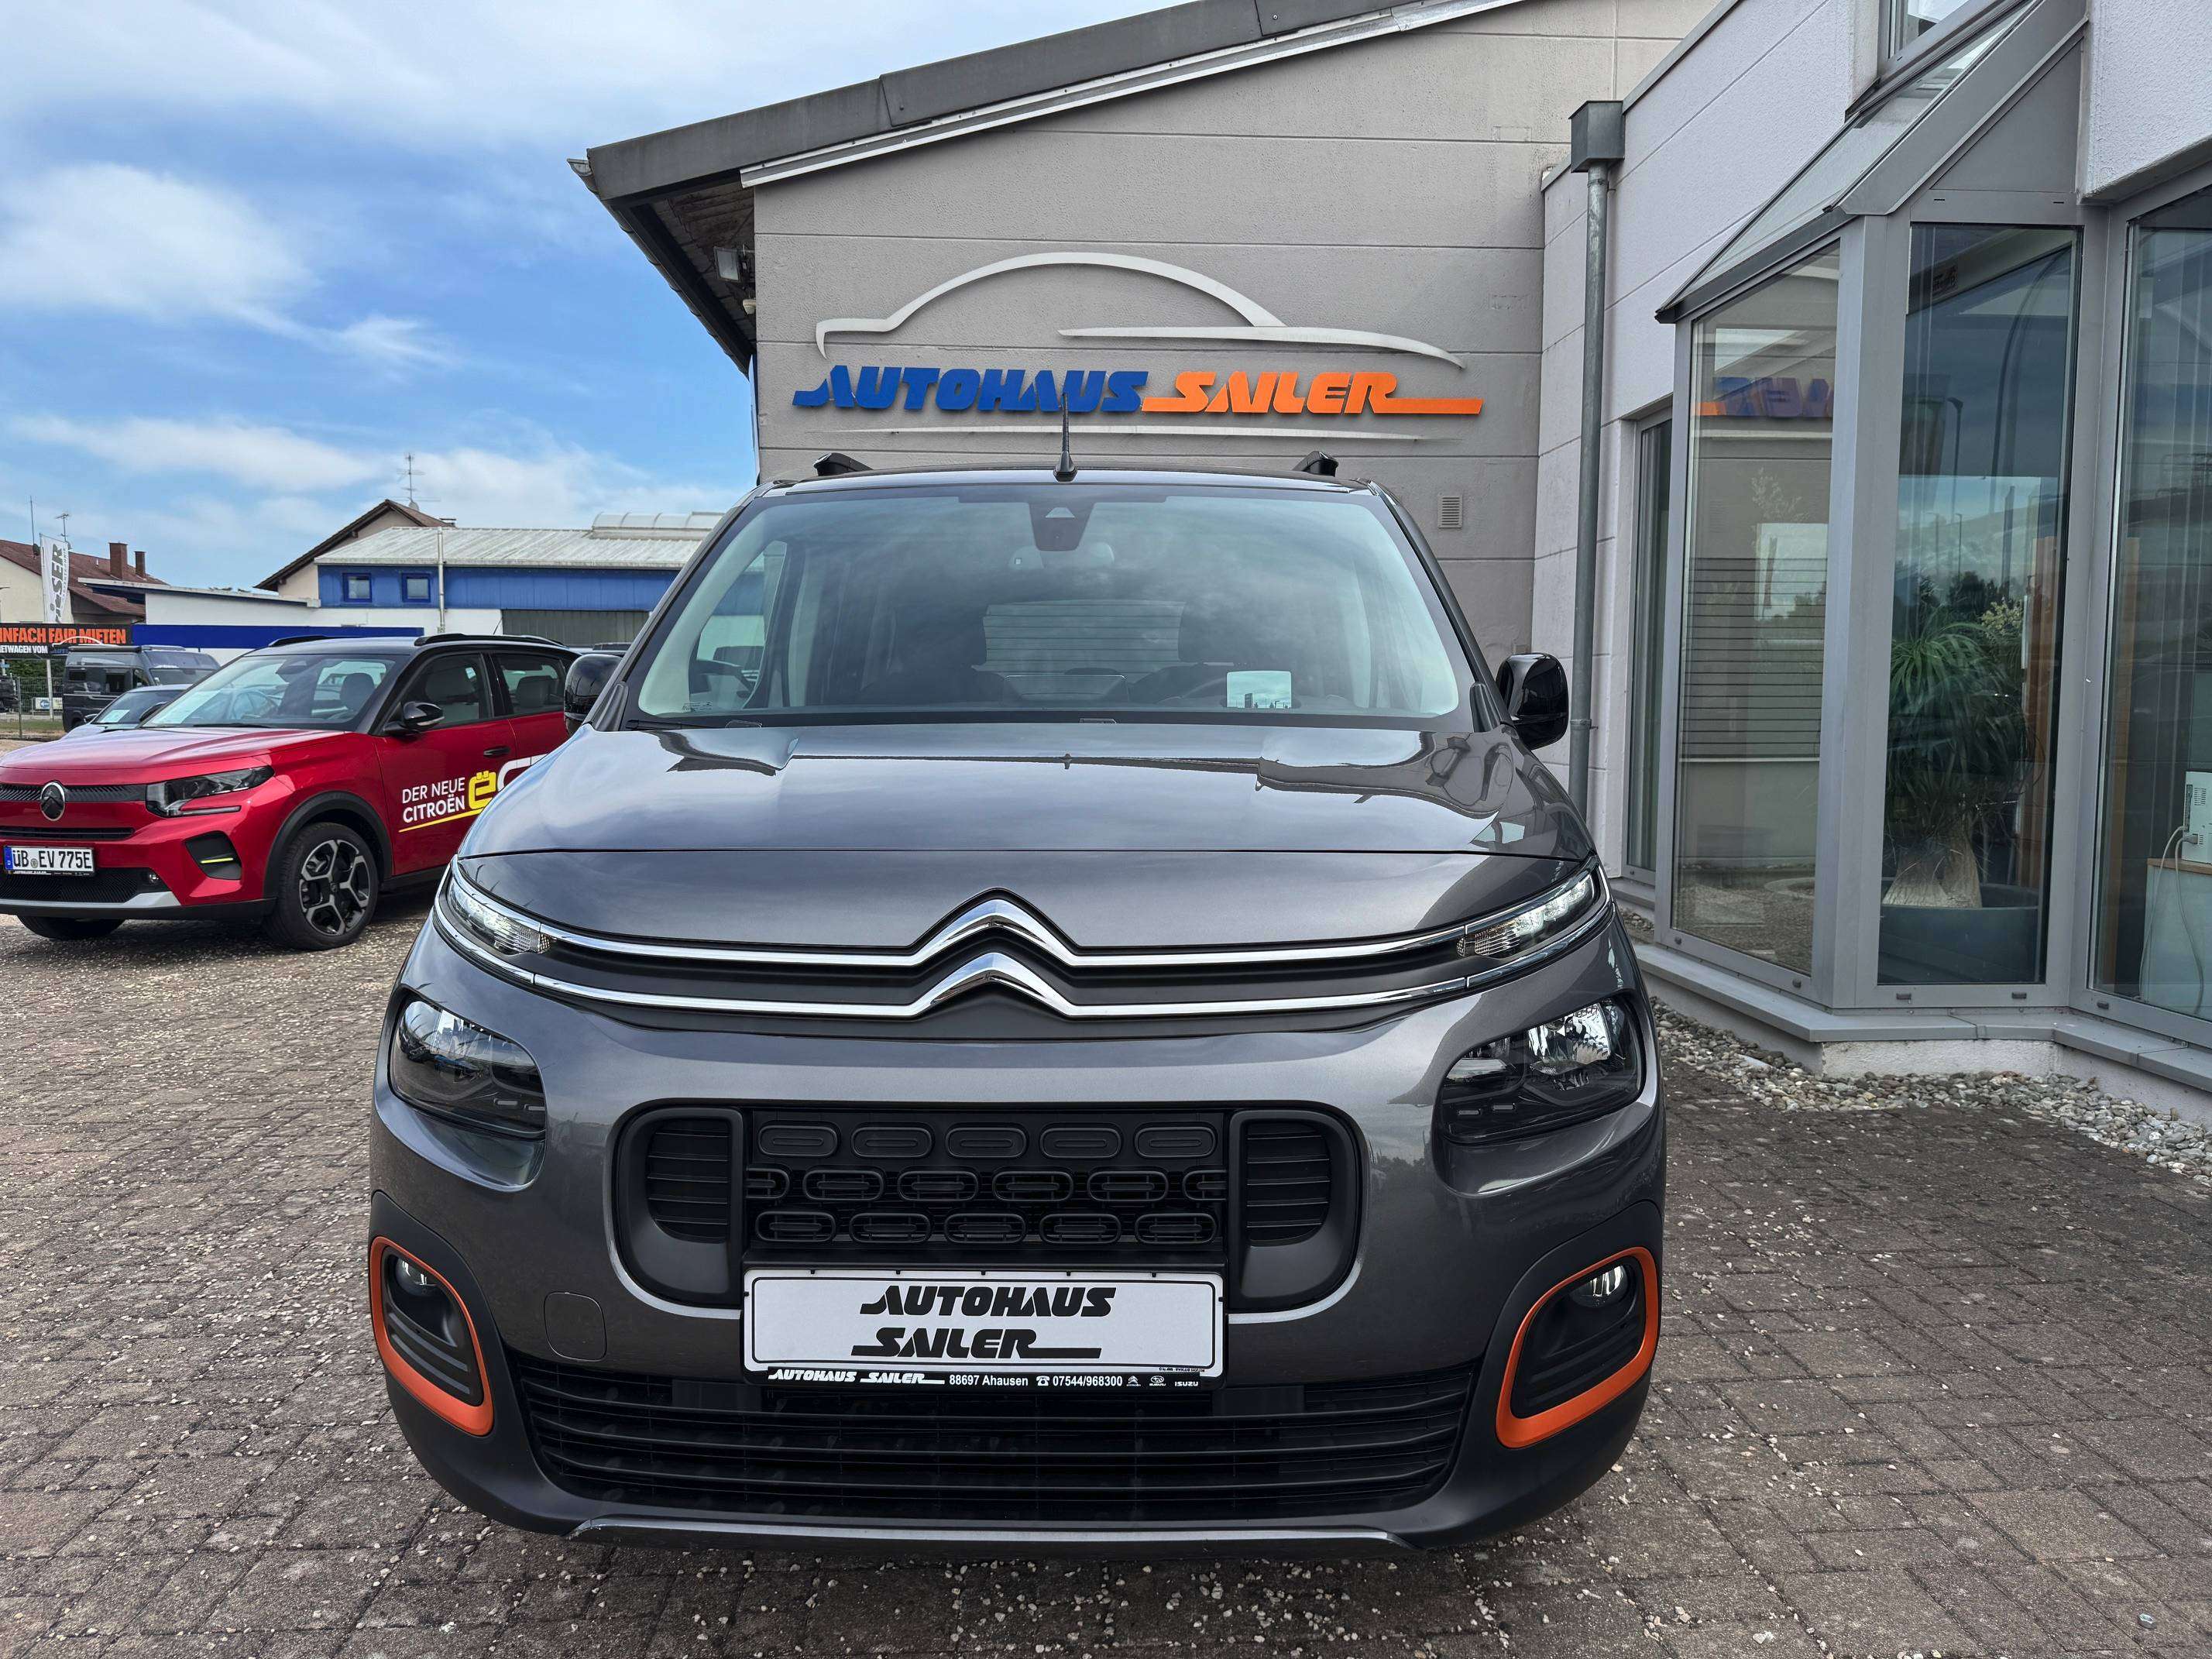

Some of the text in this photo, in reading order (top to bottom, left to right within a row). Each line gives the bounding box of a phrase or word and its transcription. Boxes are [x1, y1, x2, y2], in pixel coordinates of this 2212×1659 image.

[792, 365, 1484, 414] AUTOHAUS SAILER
[33, 645, 48, 654] VOM
[49, 628, 77, 644] FAIR
[79, 628, 126, 644] MIETEN
[402, 777, 465, 804] DER NEUE
[403, 795, 465, 823] CITROËN
[38, 850, 55, 868] EV
[58, 851, 92, 869] 775E
[860, 1284, 1117, 1317] AUTOHAUS
[851, 1327, 1103, 1359] SAILER
[768, 1369, 857, 1382] AUTOHAUS
[860, 1372, 945, 1384] SAILER
[949, 1374, 980, 1386] 88697
[982, 1375, 1029, 1386] Ahausen
[1053, 1375, 1123, 1387] 07544/968300
